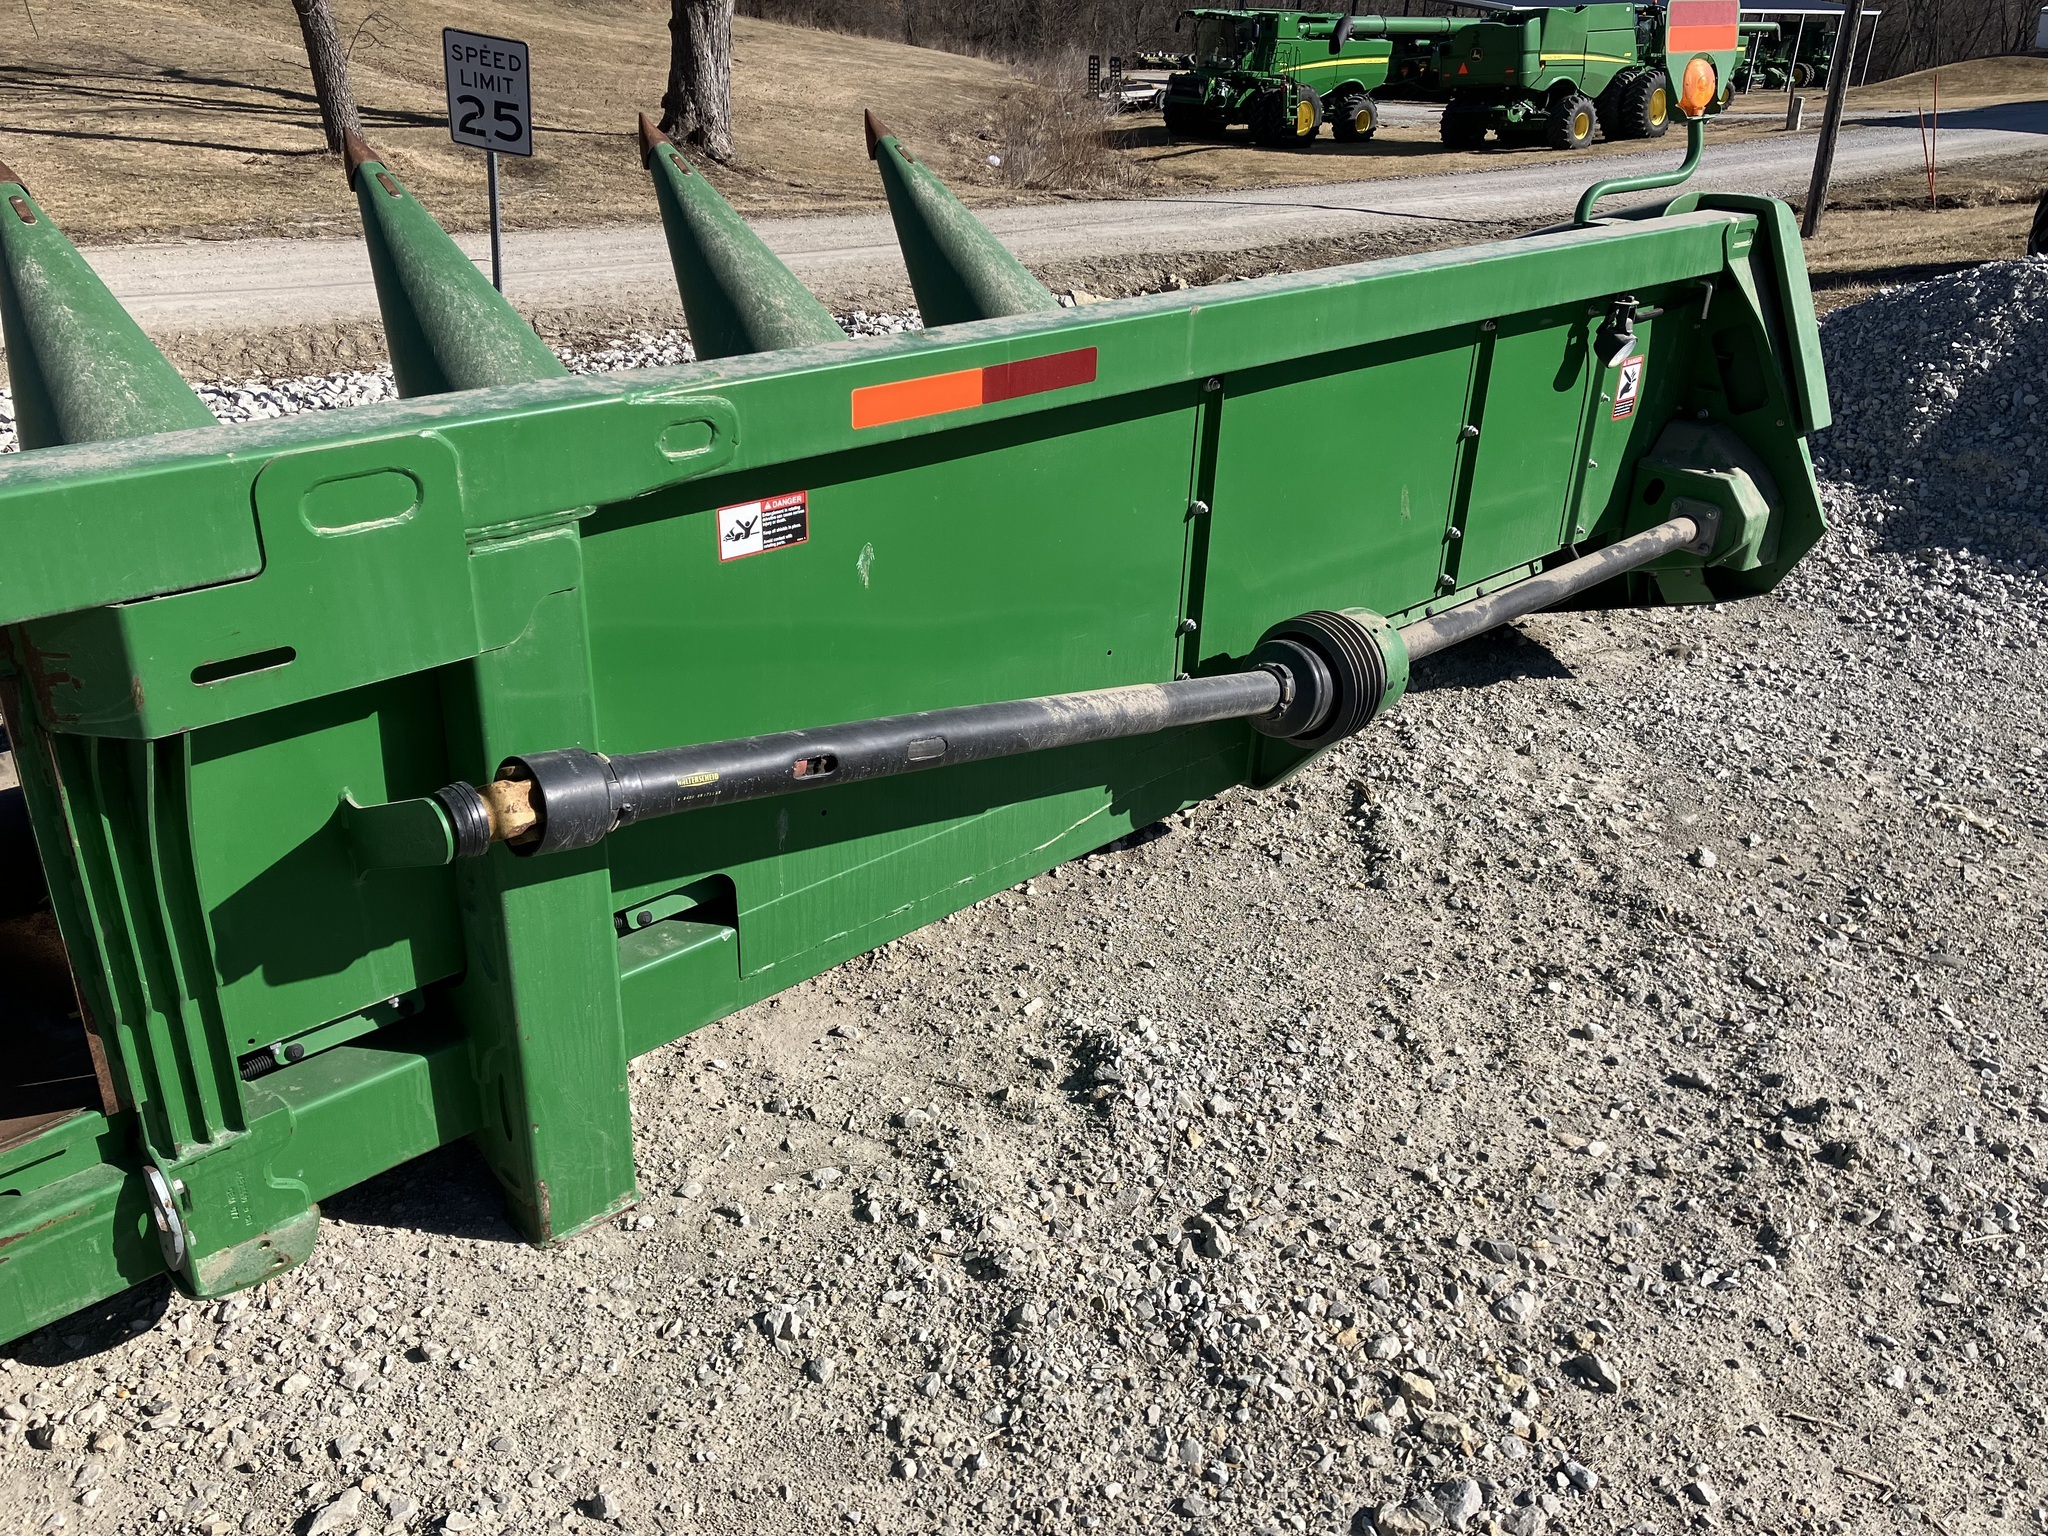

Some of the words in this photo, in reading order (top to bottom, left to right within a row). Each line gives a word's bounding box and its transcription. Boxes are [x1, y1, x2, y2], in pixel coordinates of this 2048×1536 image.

[451, 44, 521, 72] SPEED
[460, 69, 513, 94] LIMIT
[457, 94, 523, 142] 25
[772, 496, 802, 508] DANGER
[676, 772, 719, 786] WALTERSCHEID
